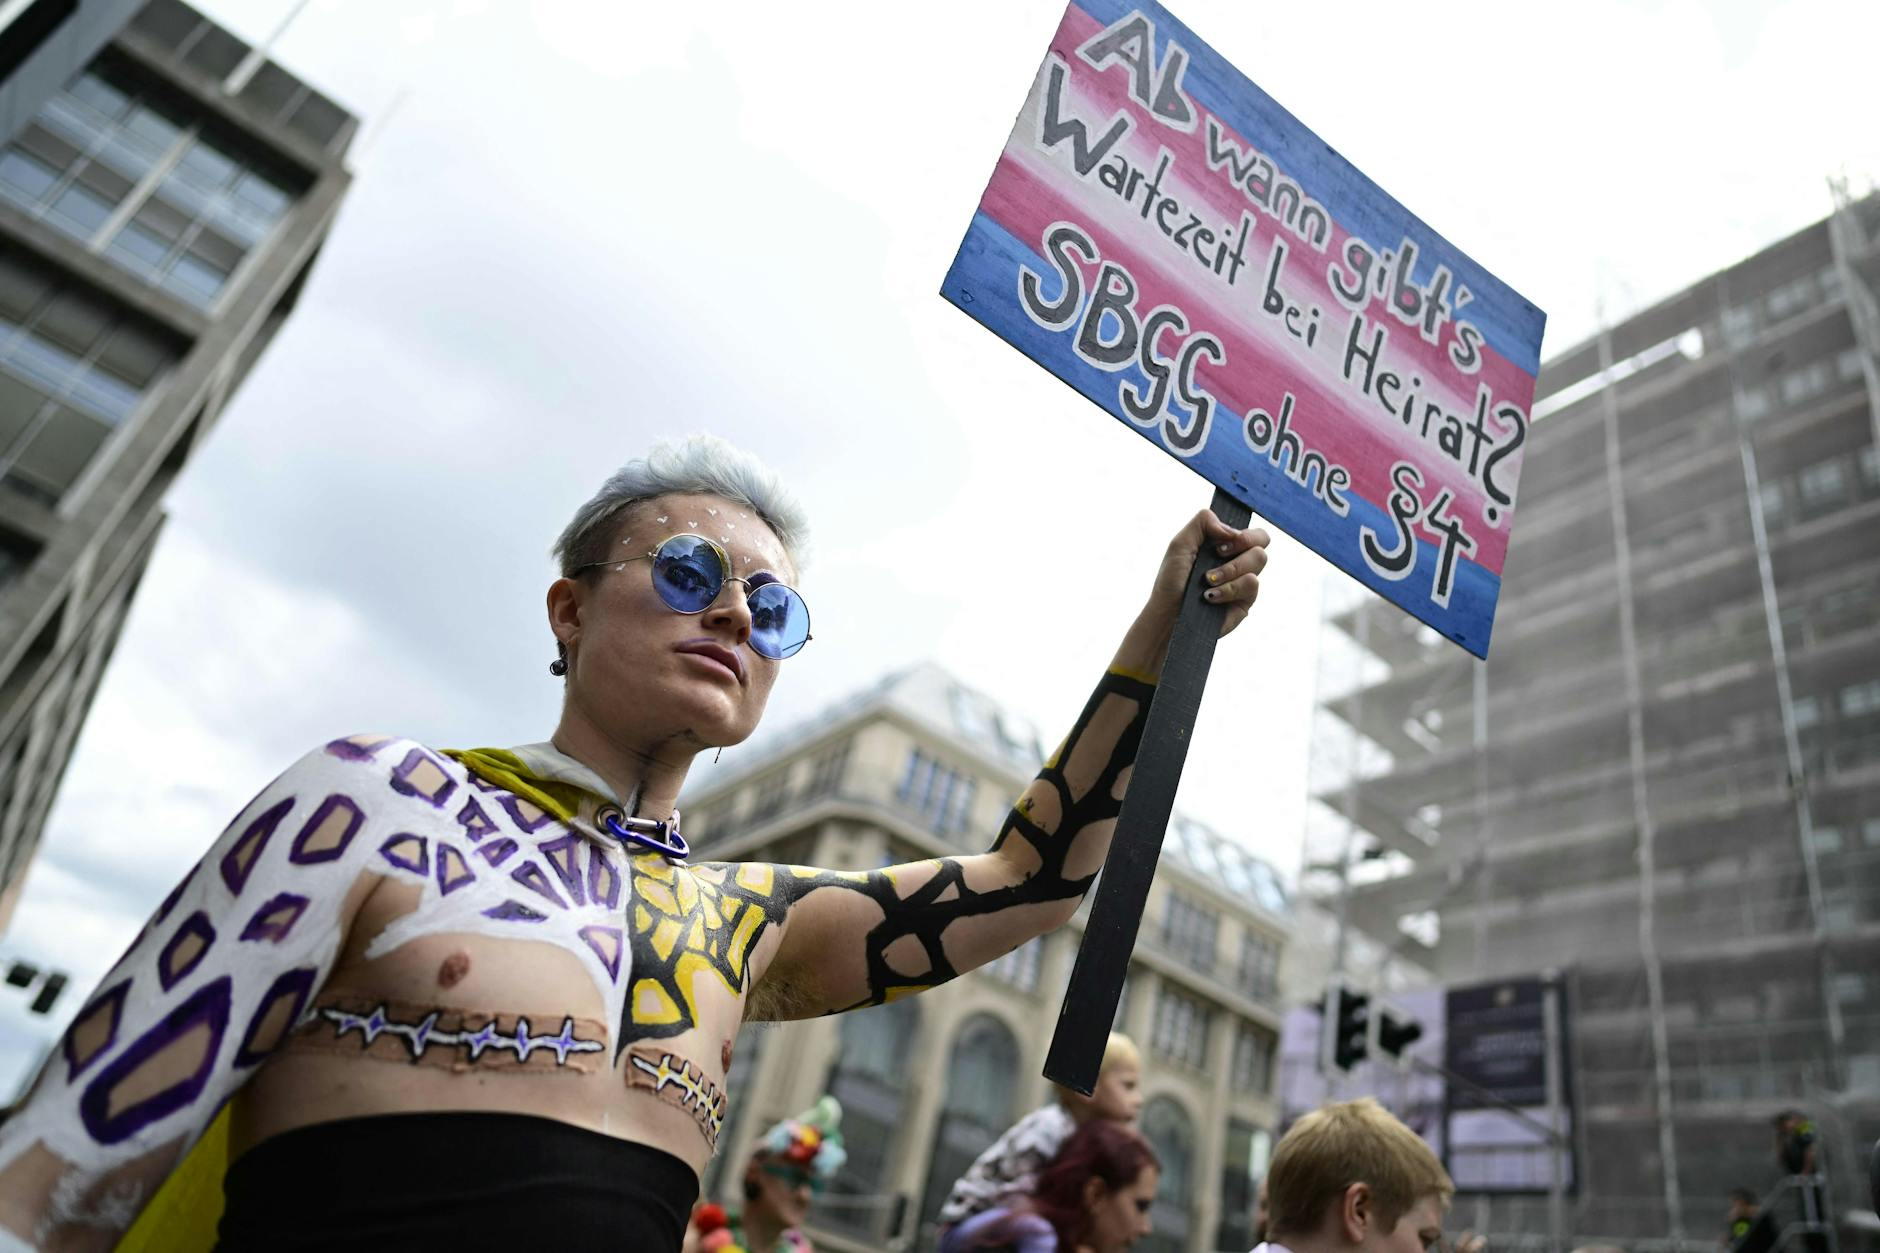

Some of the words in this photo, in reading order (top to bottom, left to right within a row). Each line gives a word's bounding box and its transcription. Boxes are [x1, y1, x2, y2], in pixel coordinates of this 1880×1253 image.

[1021, 226, 1224, 452] SBGG
[1245, 394, 1348, 511] ohne
[1041, 61, 1245, 284] Wartezeit
[1264, 245, 1320, 348] bei
[1343, 319, 1526, 523] Heirat?
[1079, 13, 1194, 128] Ab
[1207, 123, 1332, 249] wann
[1332, 240, 1481, 373] gibt's
